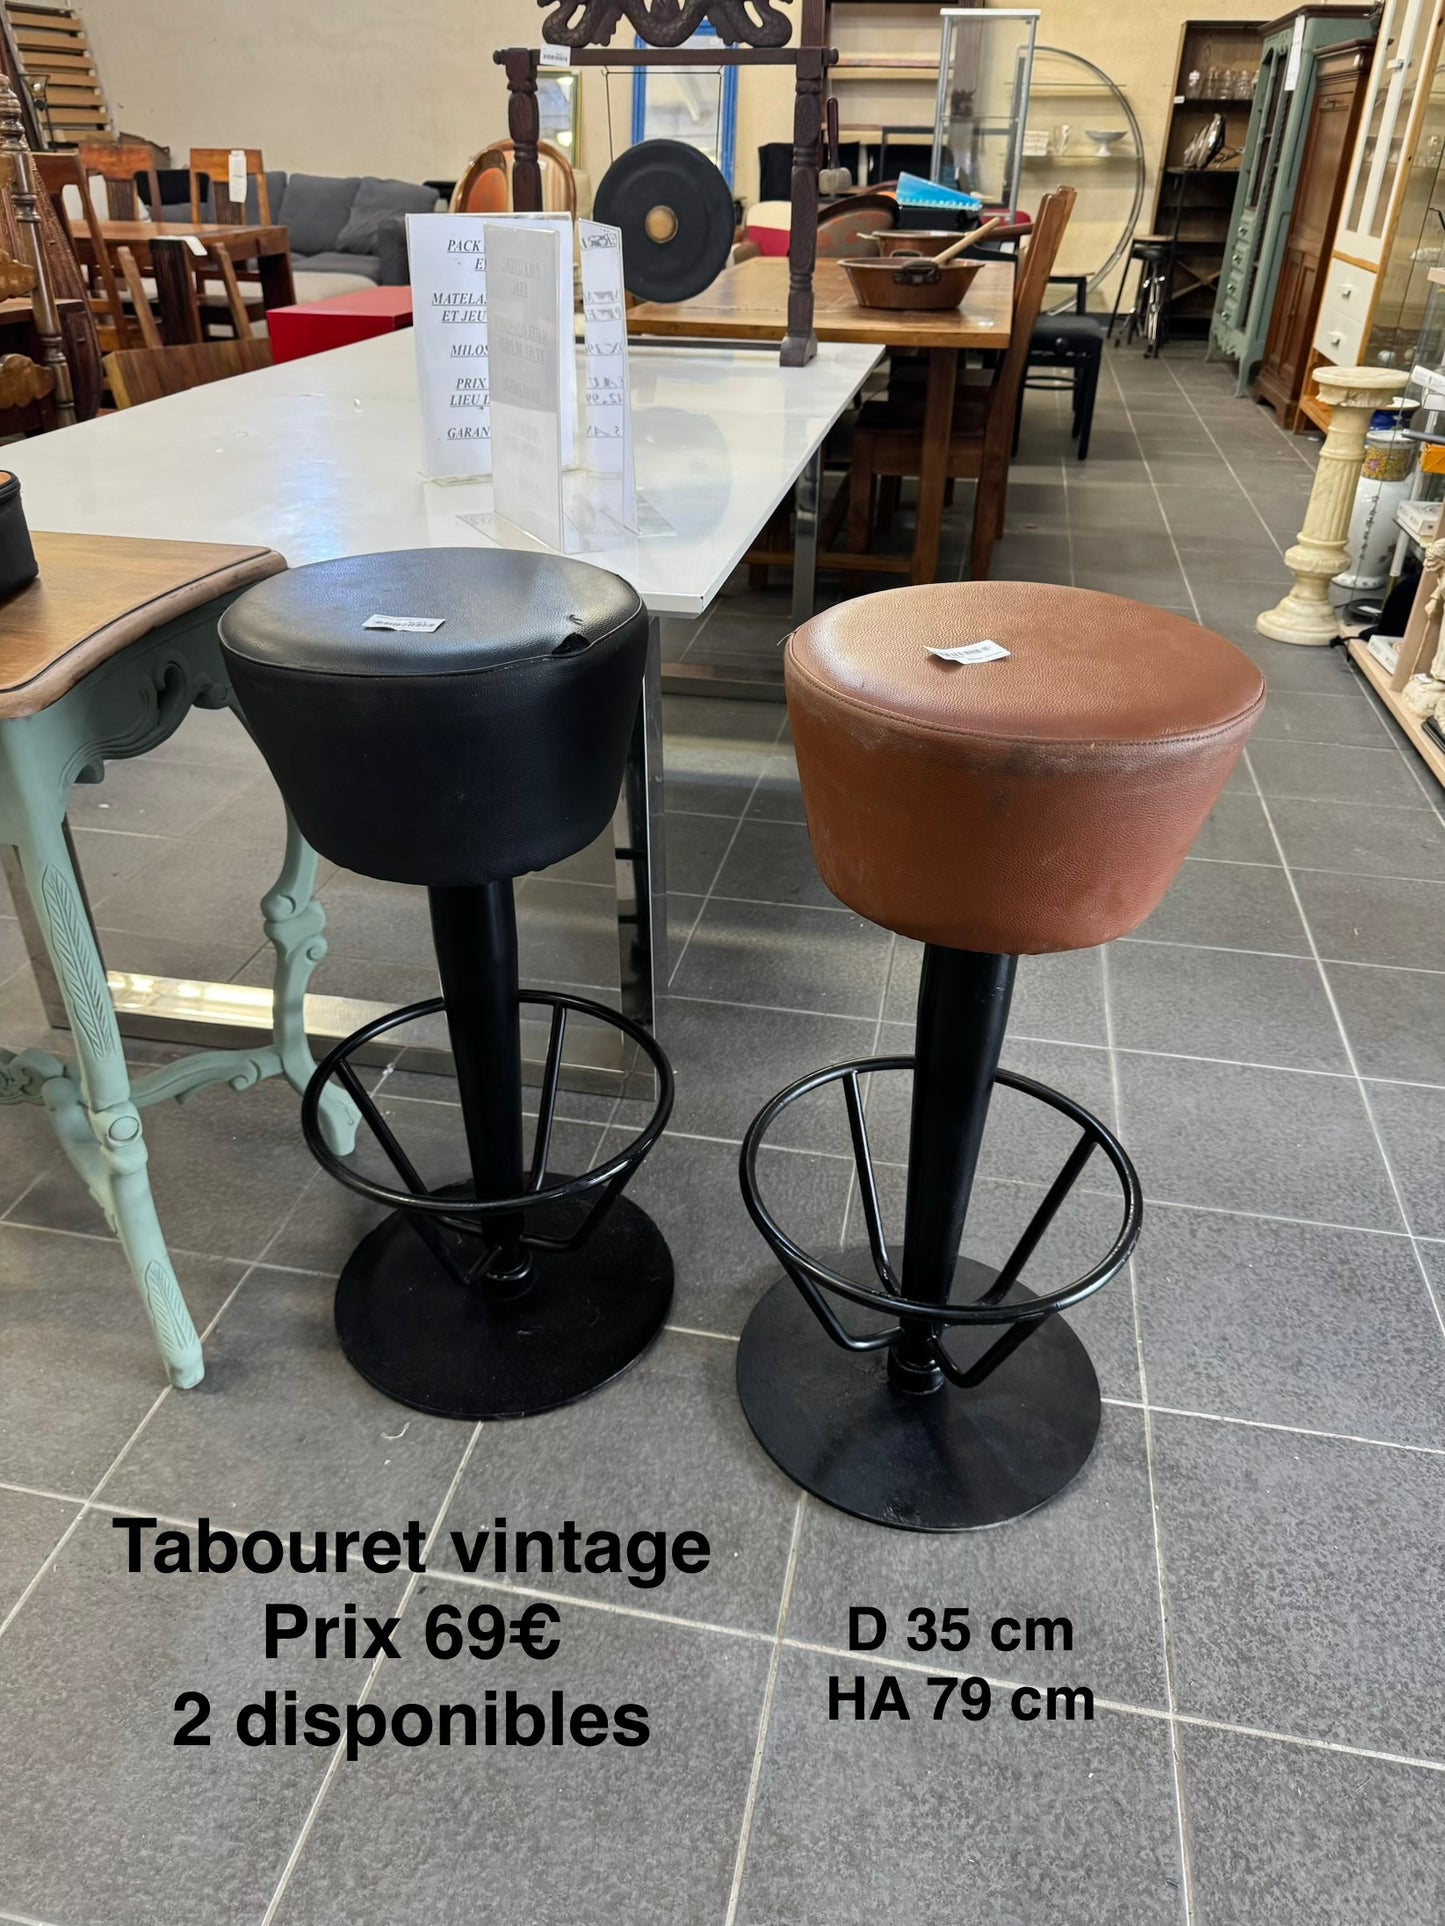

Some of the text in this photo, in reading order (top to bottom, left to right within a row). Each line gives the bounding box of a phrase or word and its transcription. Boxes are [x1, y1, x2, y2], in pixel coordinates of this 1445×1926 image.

[447, 239, 481, 253] PACK
[442, 310, 487, 323] ET JEU
[456, 377, 487, 390] PRIX
[450, 394, 480, 407] LIEU
